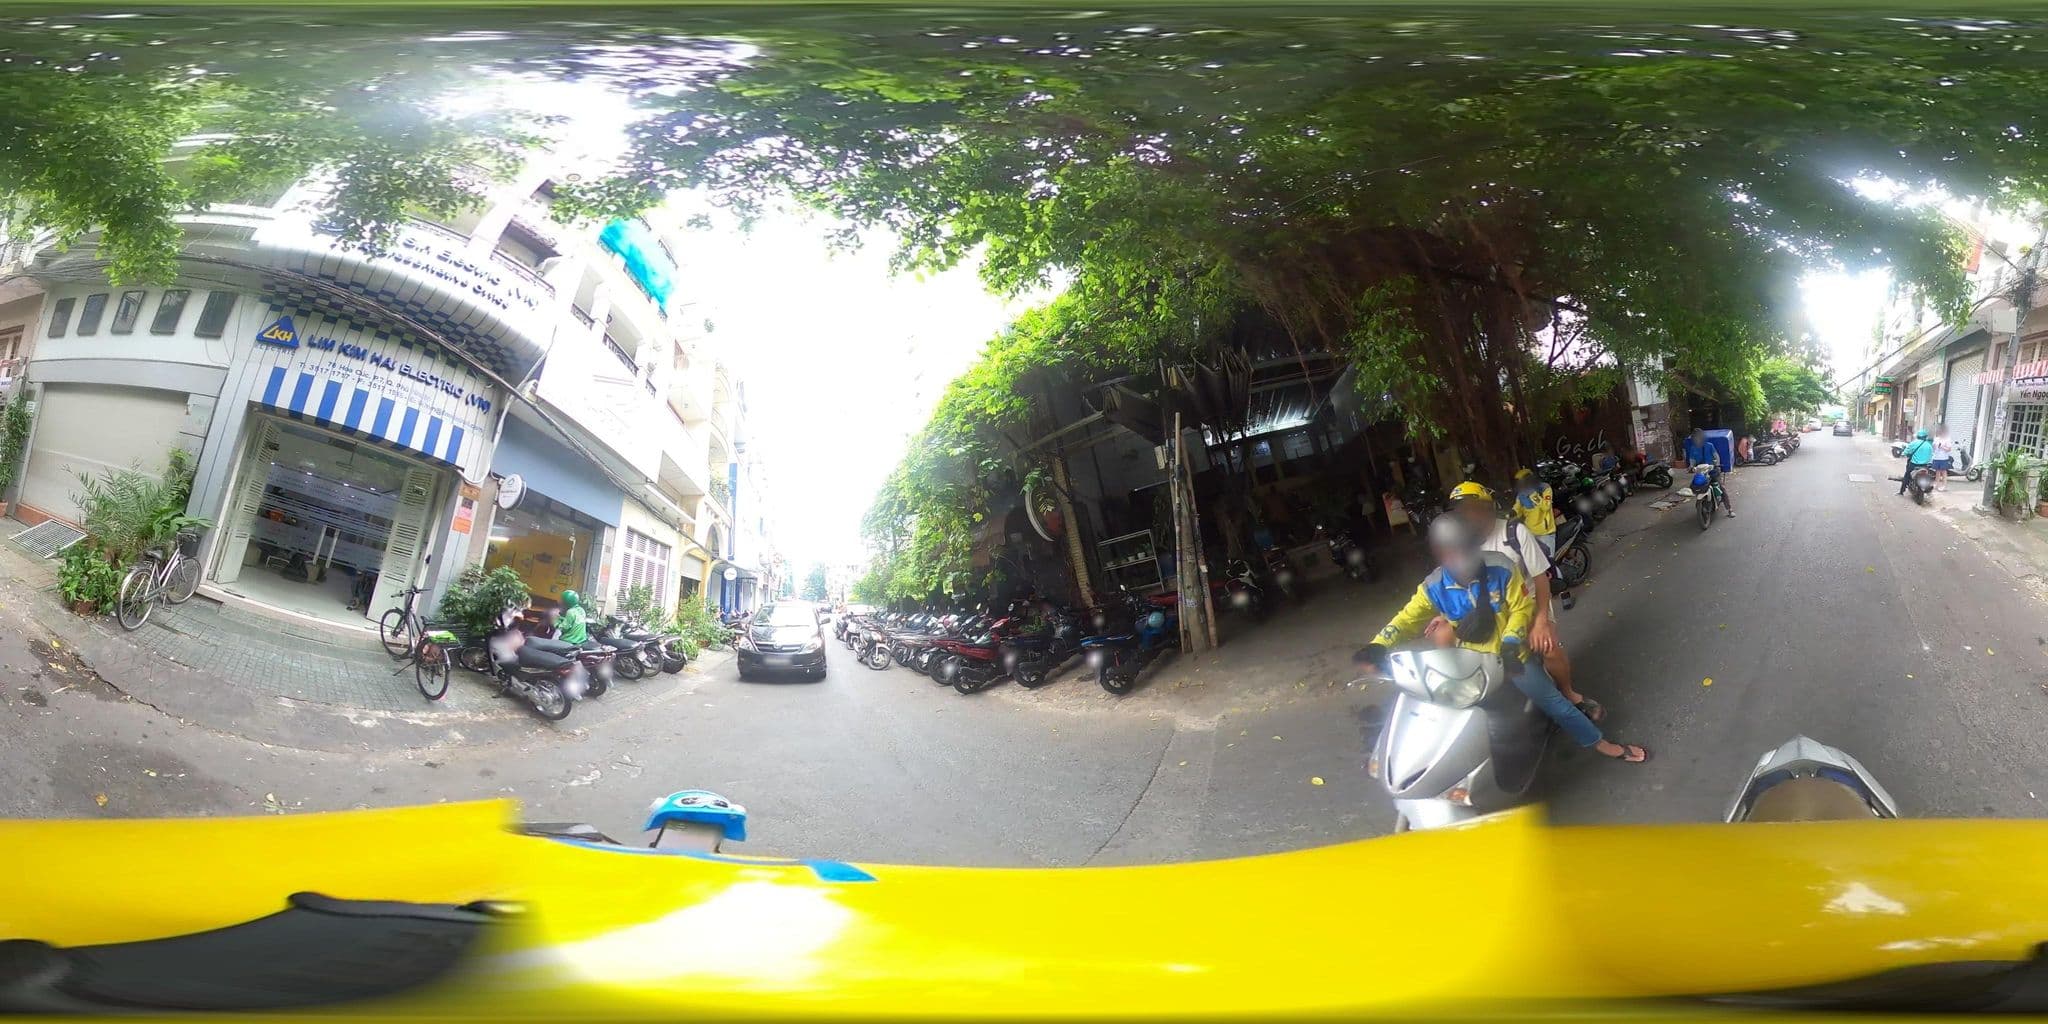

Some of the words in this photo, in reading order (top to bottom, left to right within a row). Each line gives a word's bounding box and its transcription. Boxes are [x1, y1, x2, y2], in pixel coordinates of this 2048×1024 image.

[263, 325, 293, 342] LKH
[308, 334, 336, 352] LIM
[338, 342, 368, 361] KIM
[399, 363, 464, 399] ELECTRIC
[465, 393, 491, 415] (VN)
